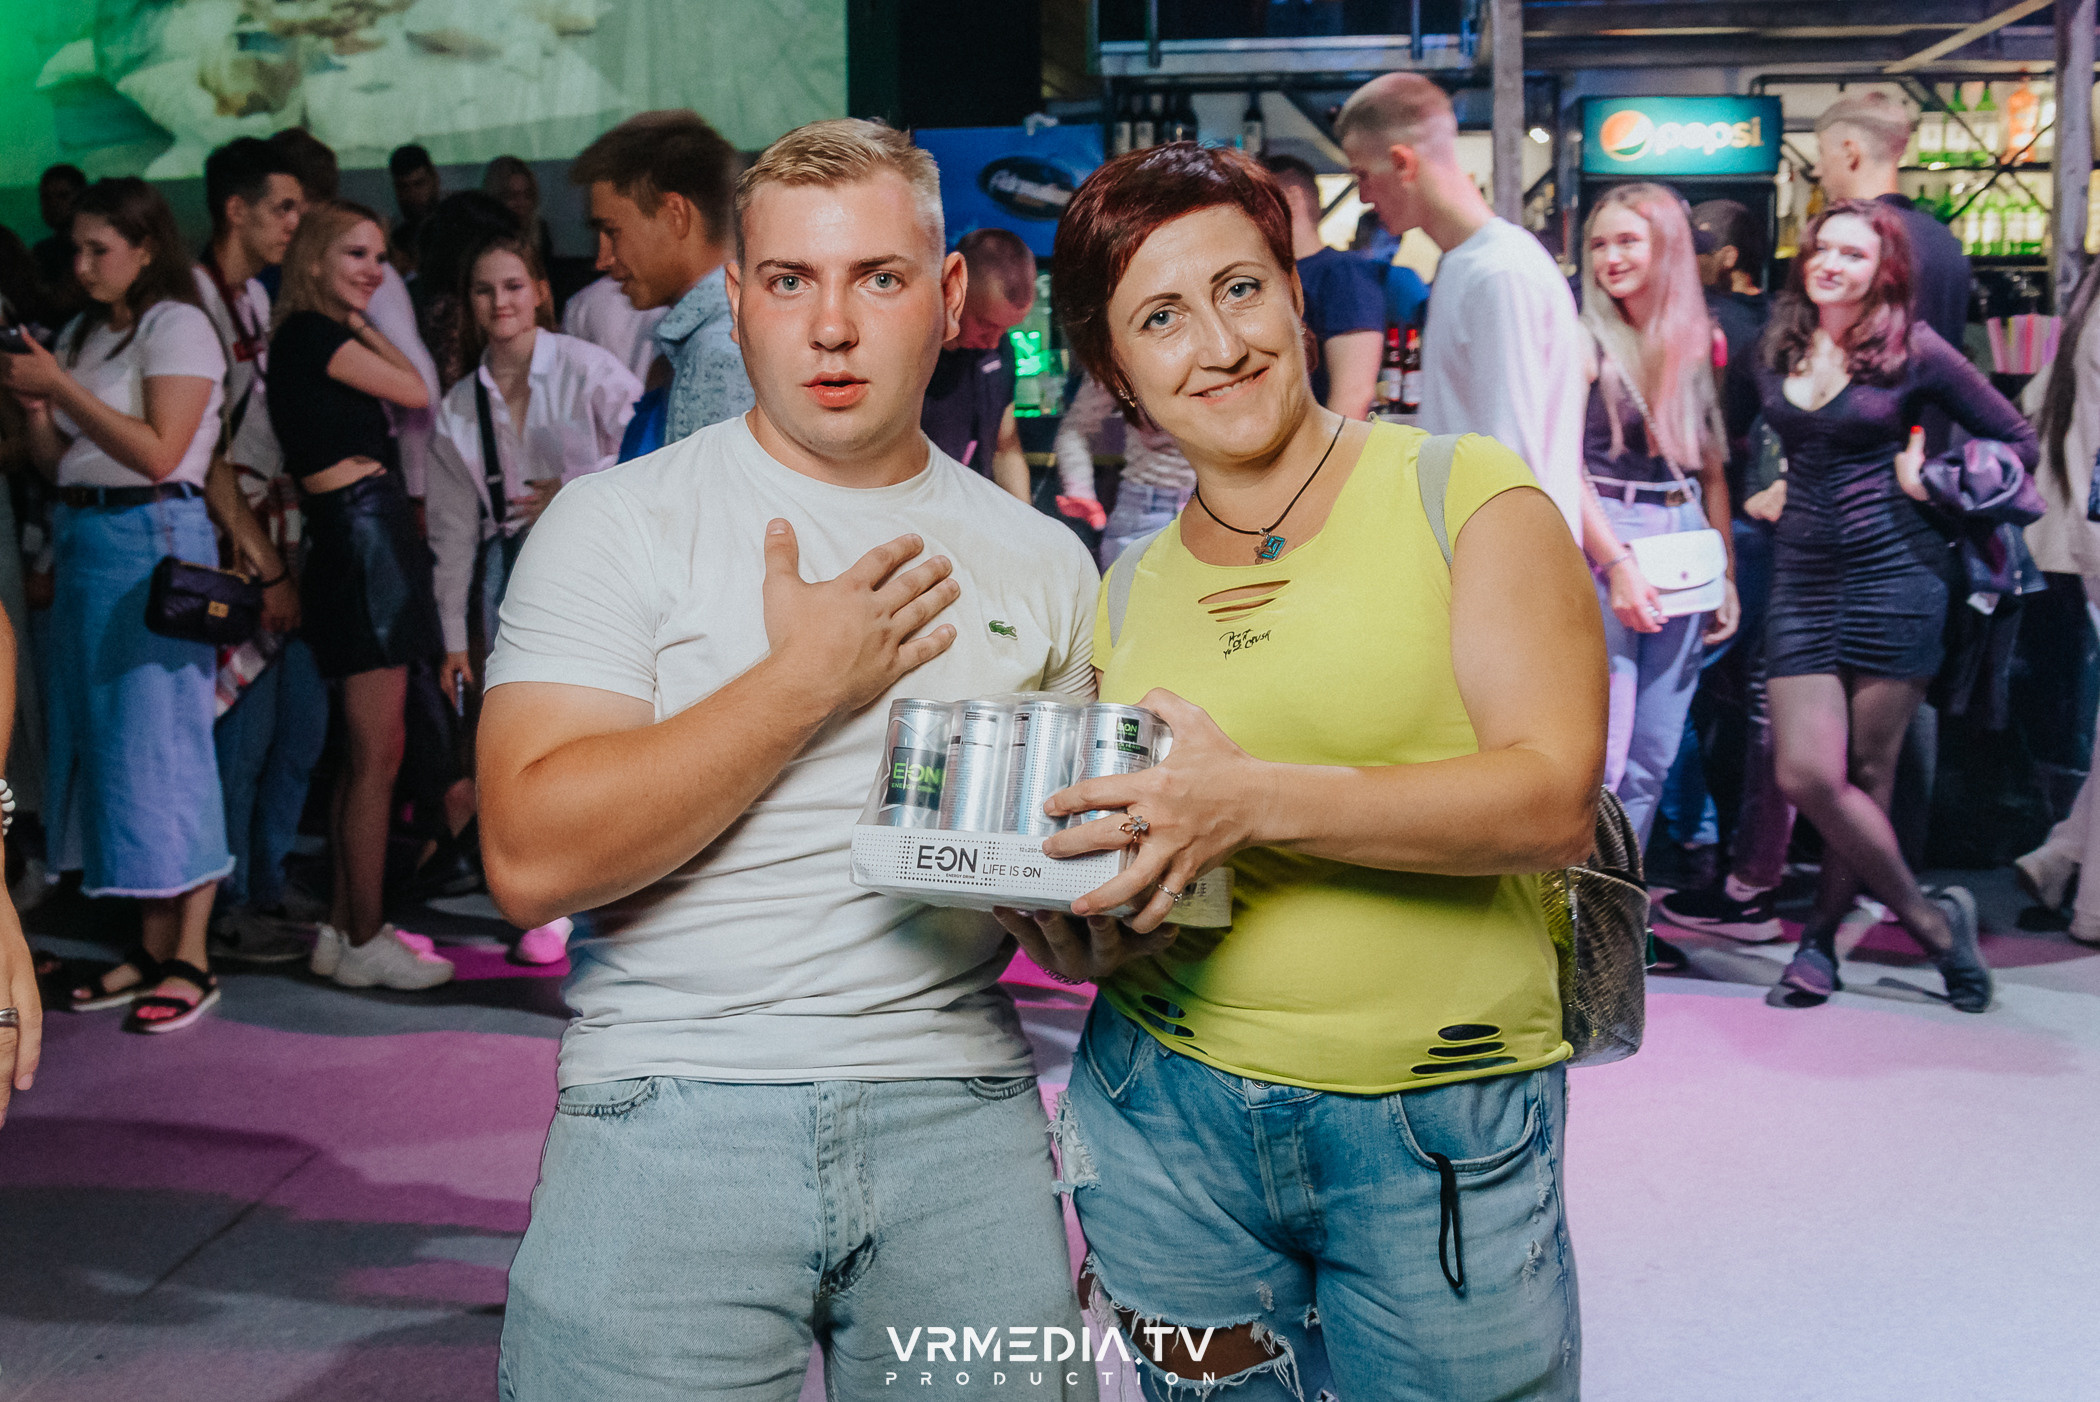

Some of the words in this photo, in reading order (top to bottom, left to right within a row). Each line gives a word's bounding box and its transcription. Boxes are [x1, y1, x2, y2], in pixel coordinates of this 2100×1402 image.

[1653, 116, 1764, 156] pepsi
[982, 863, 1007, 876] LIFE
[1009, 865, 1019, 877] IS
[1022, 866, 1042, 878] ON
